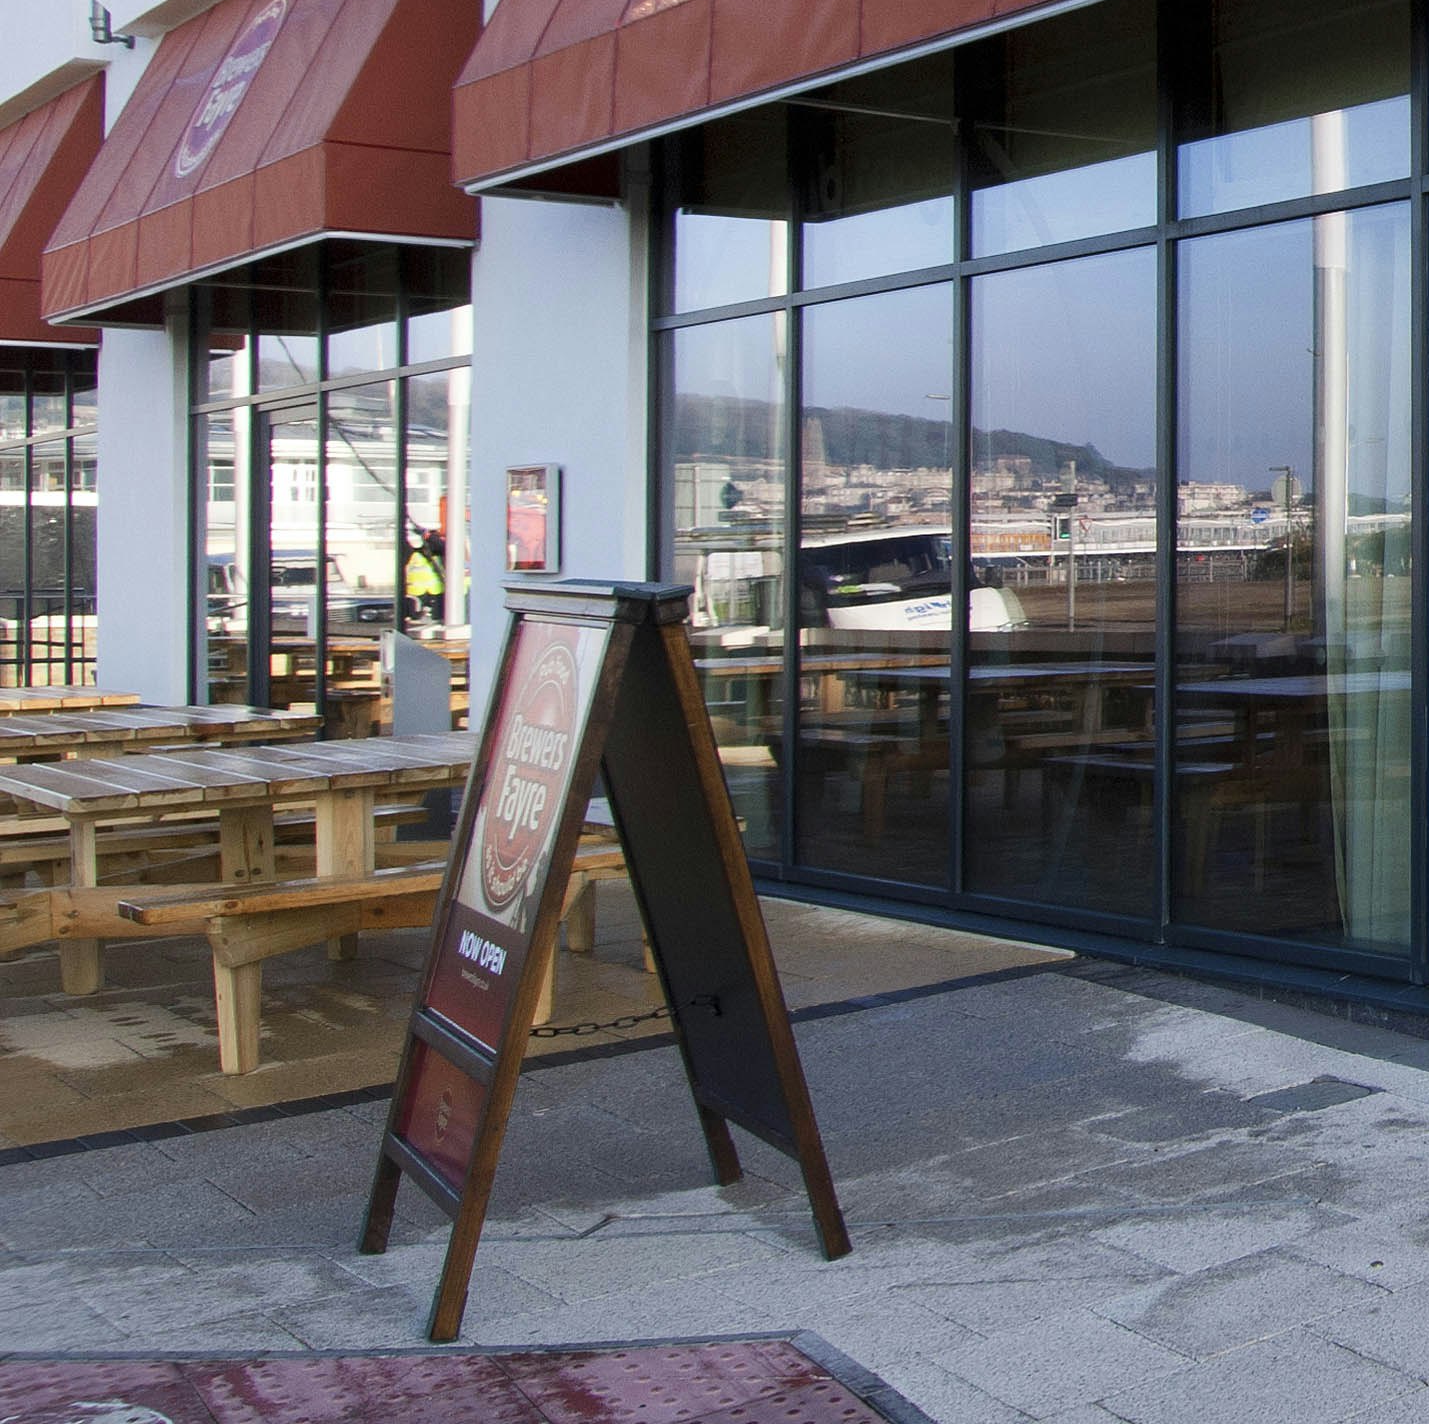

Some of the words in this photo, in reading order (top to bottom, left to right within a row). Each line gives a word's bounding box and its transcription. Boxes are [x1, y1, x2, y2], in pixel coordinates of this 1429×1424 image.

[506, 713, 569, 771] Brewers
[496, 764, 548, 841] Fayre
[459, 929, 484, 962] NOW
[480, 940, 508, 975] OPEN
